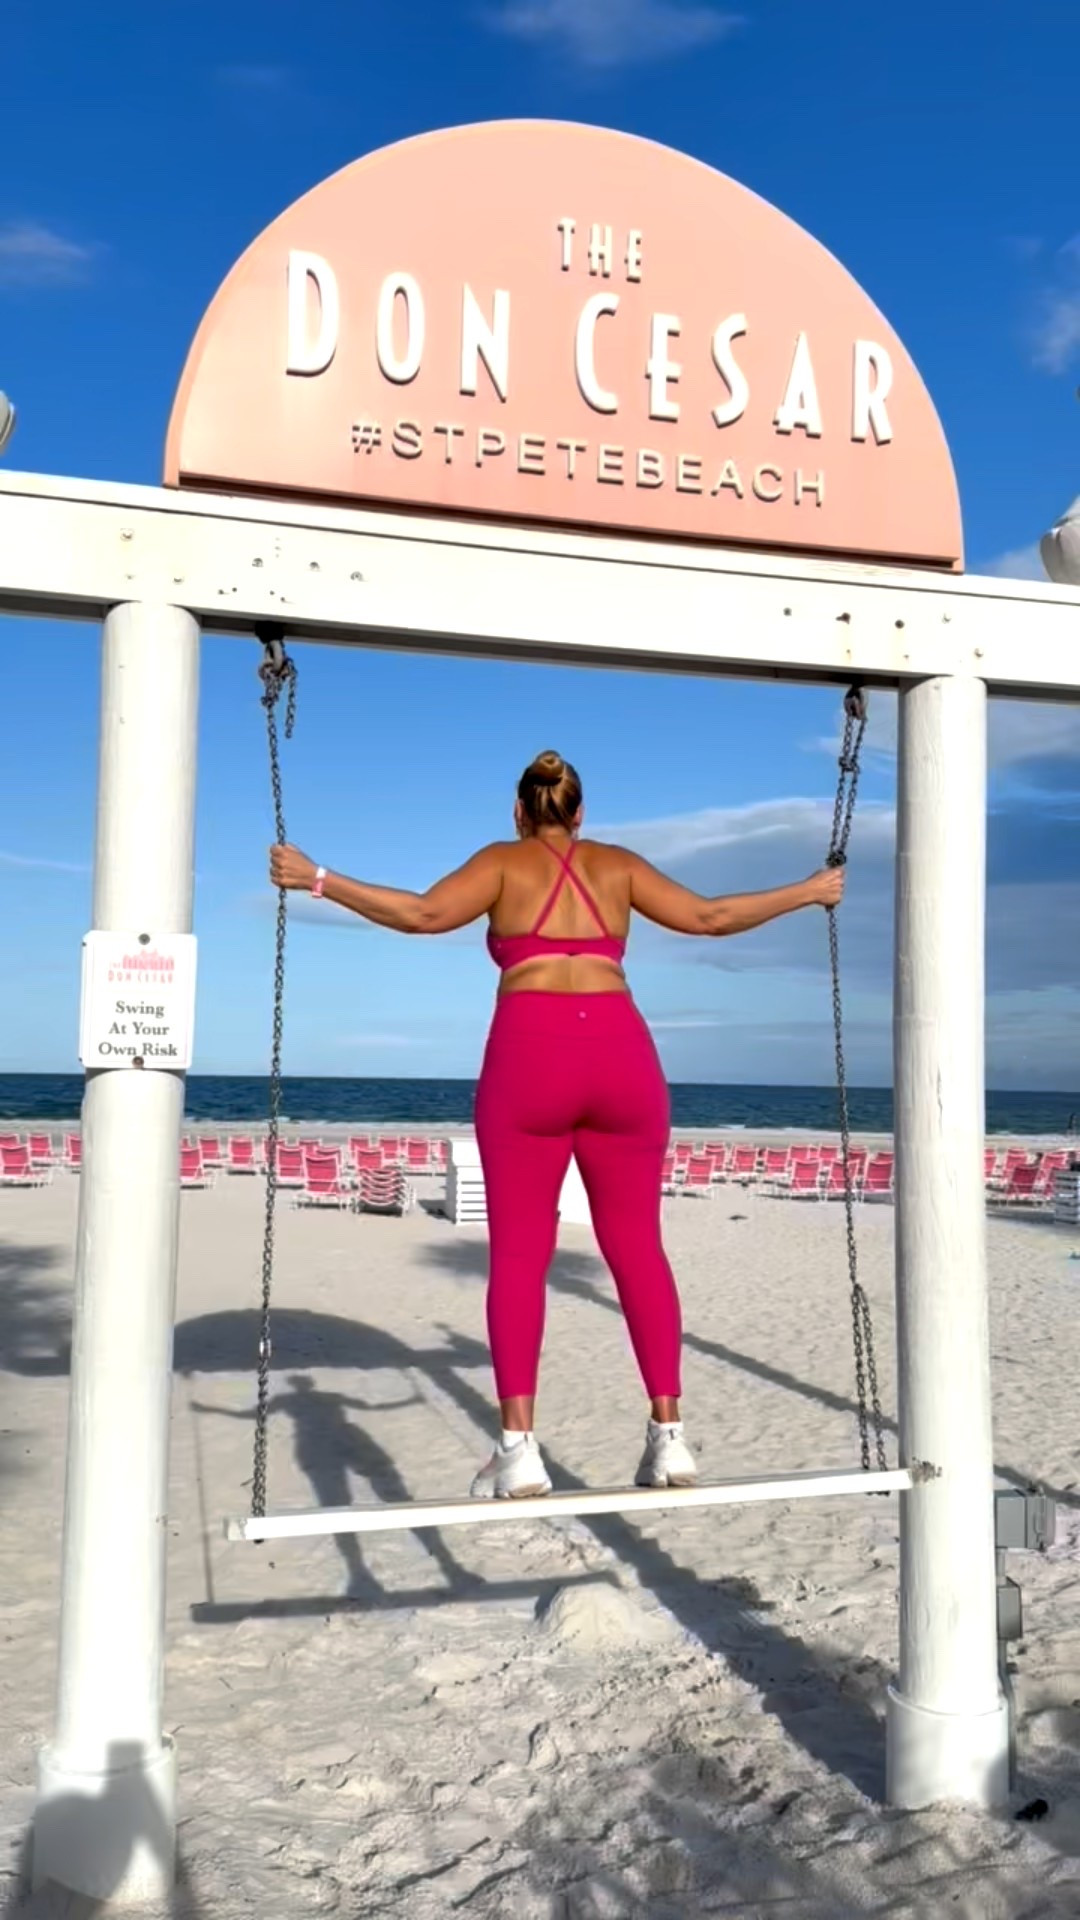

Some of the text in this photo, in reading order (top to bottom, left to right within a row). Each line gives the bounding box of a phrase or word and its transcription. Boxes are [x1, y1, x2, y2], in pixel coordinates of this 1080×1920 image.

[556, 217, 642, 283] THE
[286, 248, 894, 447] DON CESAR
[351, 415, 825, 507] #STPETEBEACH
[108, 1021, 170, 1035] At Your
[115, 1000, 165, 1018] Swing
[98, 1041, 178, 1056] Own Risk
